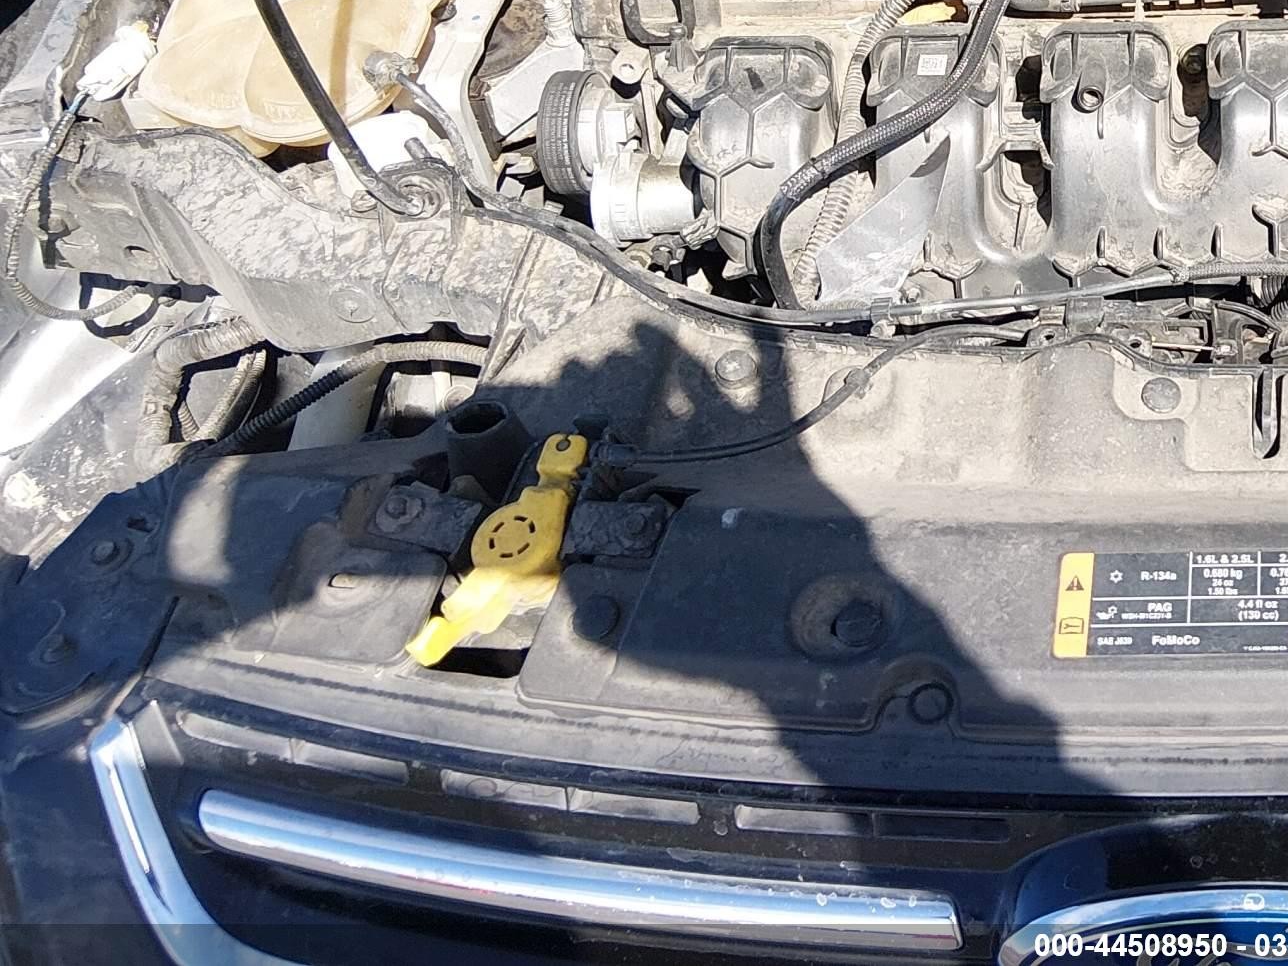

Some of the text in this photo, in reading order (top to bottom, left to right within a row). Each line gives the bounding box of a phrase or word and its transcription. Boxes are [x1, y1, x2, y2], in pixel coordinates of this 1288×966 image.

[1196, 554, 1254, 564] 1.6L & 2.5L
[1140, 570, 1177, 581] R-134a
[1230, 568, 1243, 580] kg
[1223, 579, 1234, 587] oz
[1225, 587, 1239, 595] lbs
[1147, 602, 1173, 612] PAG
[1238, 599, 1279, 609] 4.4 fl oz
[1262, 610, 1279, 621] cc)
[1097, 636, 1114, 646] SAE
[1151, 634, 1201, 646] FoMoCo
